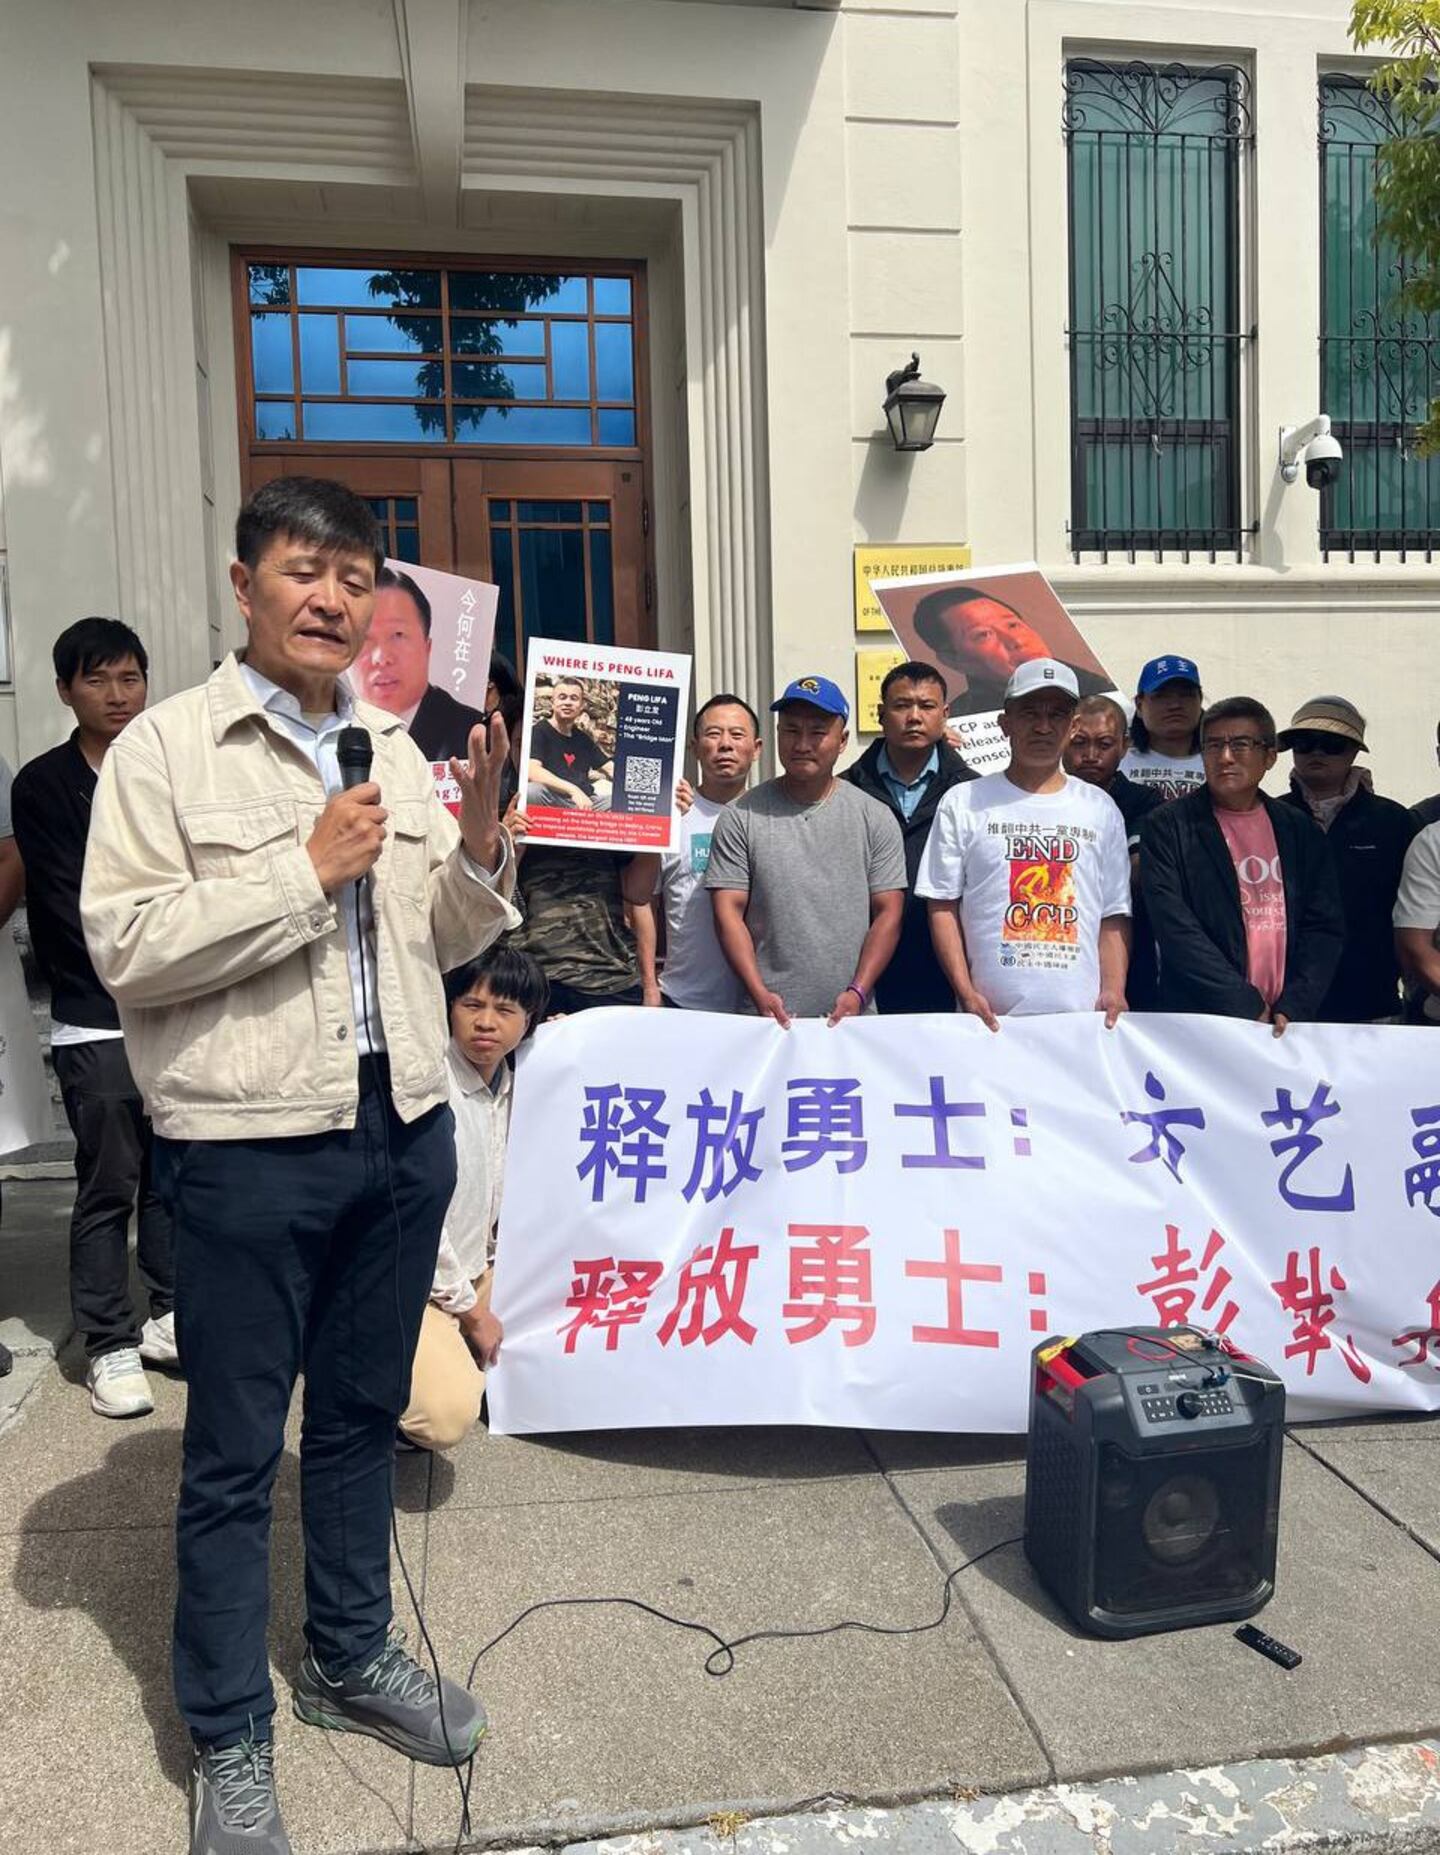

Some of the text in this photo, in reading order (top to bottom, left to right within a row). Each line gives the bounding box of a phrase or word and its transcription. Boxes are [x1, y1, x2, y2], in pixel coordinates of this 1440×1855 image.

[452, 589, 477, 692] 今何在？
[543, 655, 674, 679] WHERE IS PENG LIFA
[628, 693, 667, 704] PENG LIFA
[951, 721, 977, 733] CP
[1005, 836, 1080, 863] END
[1005, 901, 1079, 932] CCP
